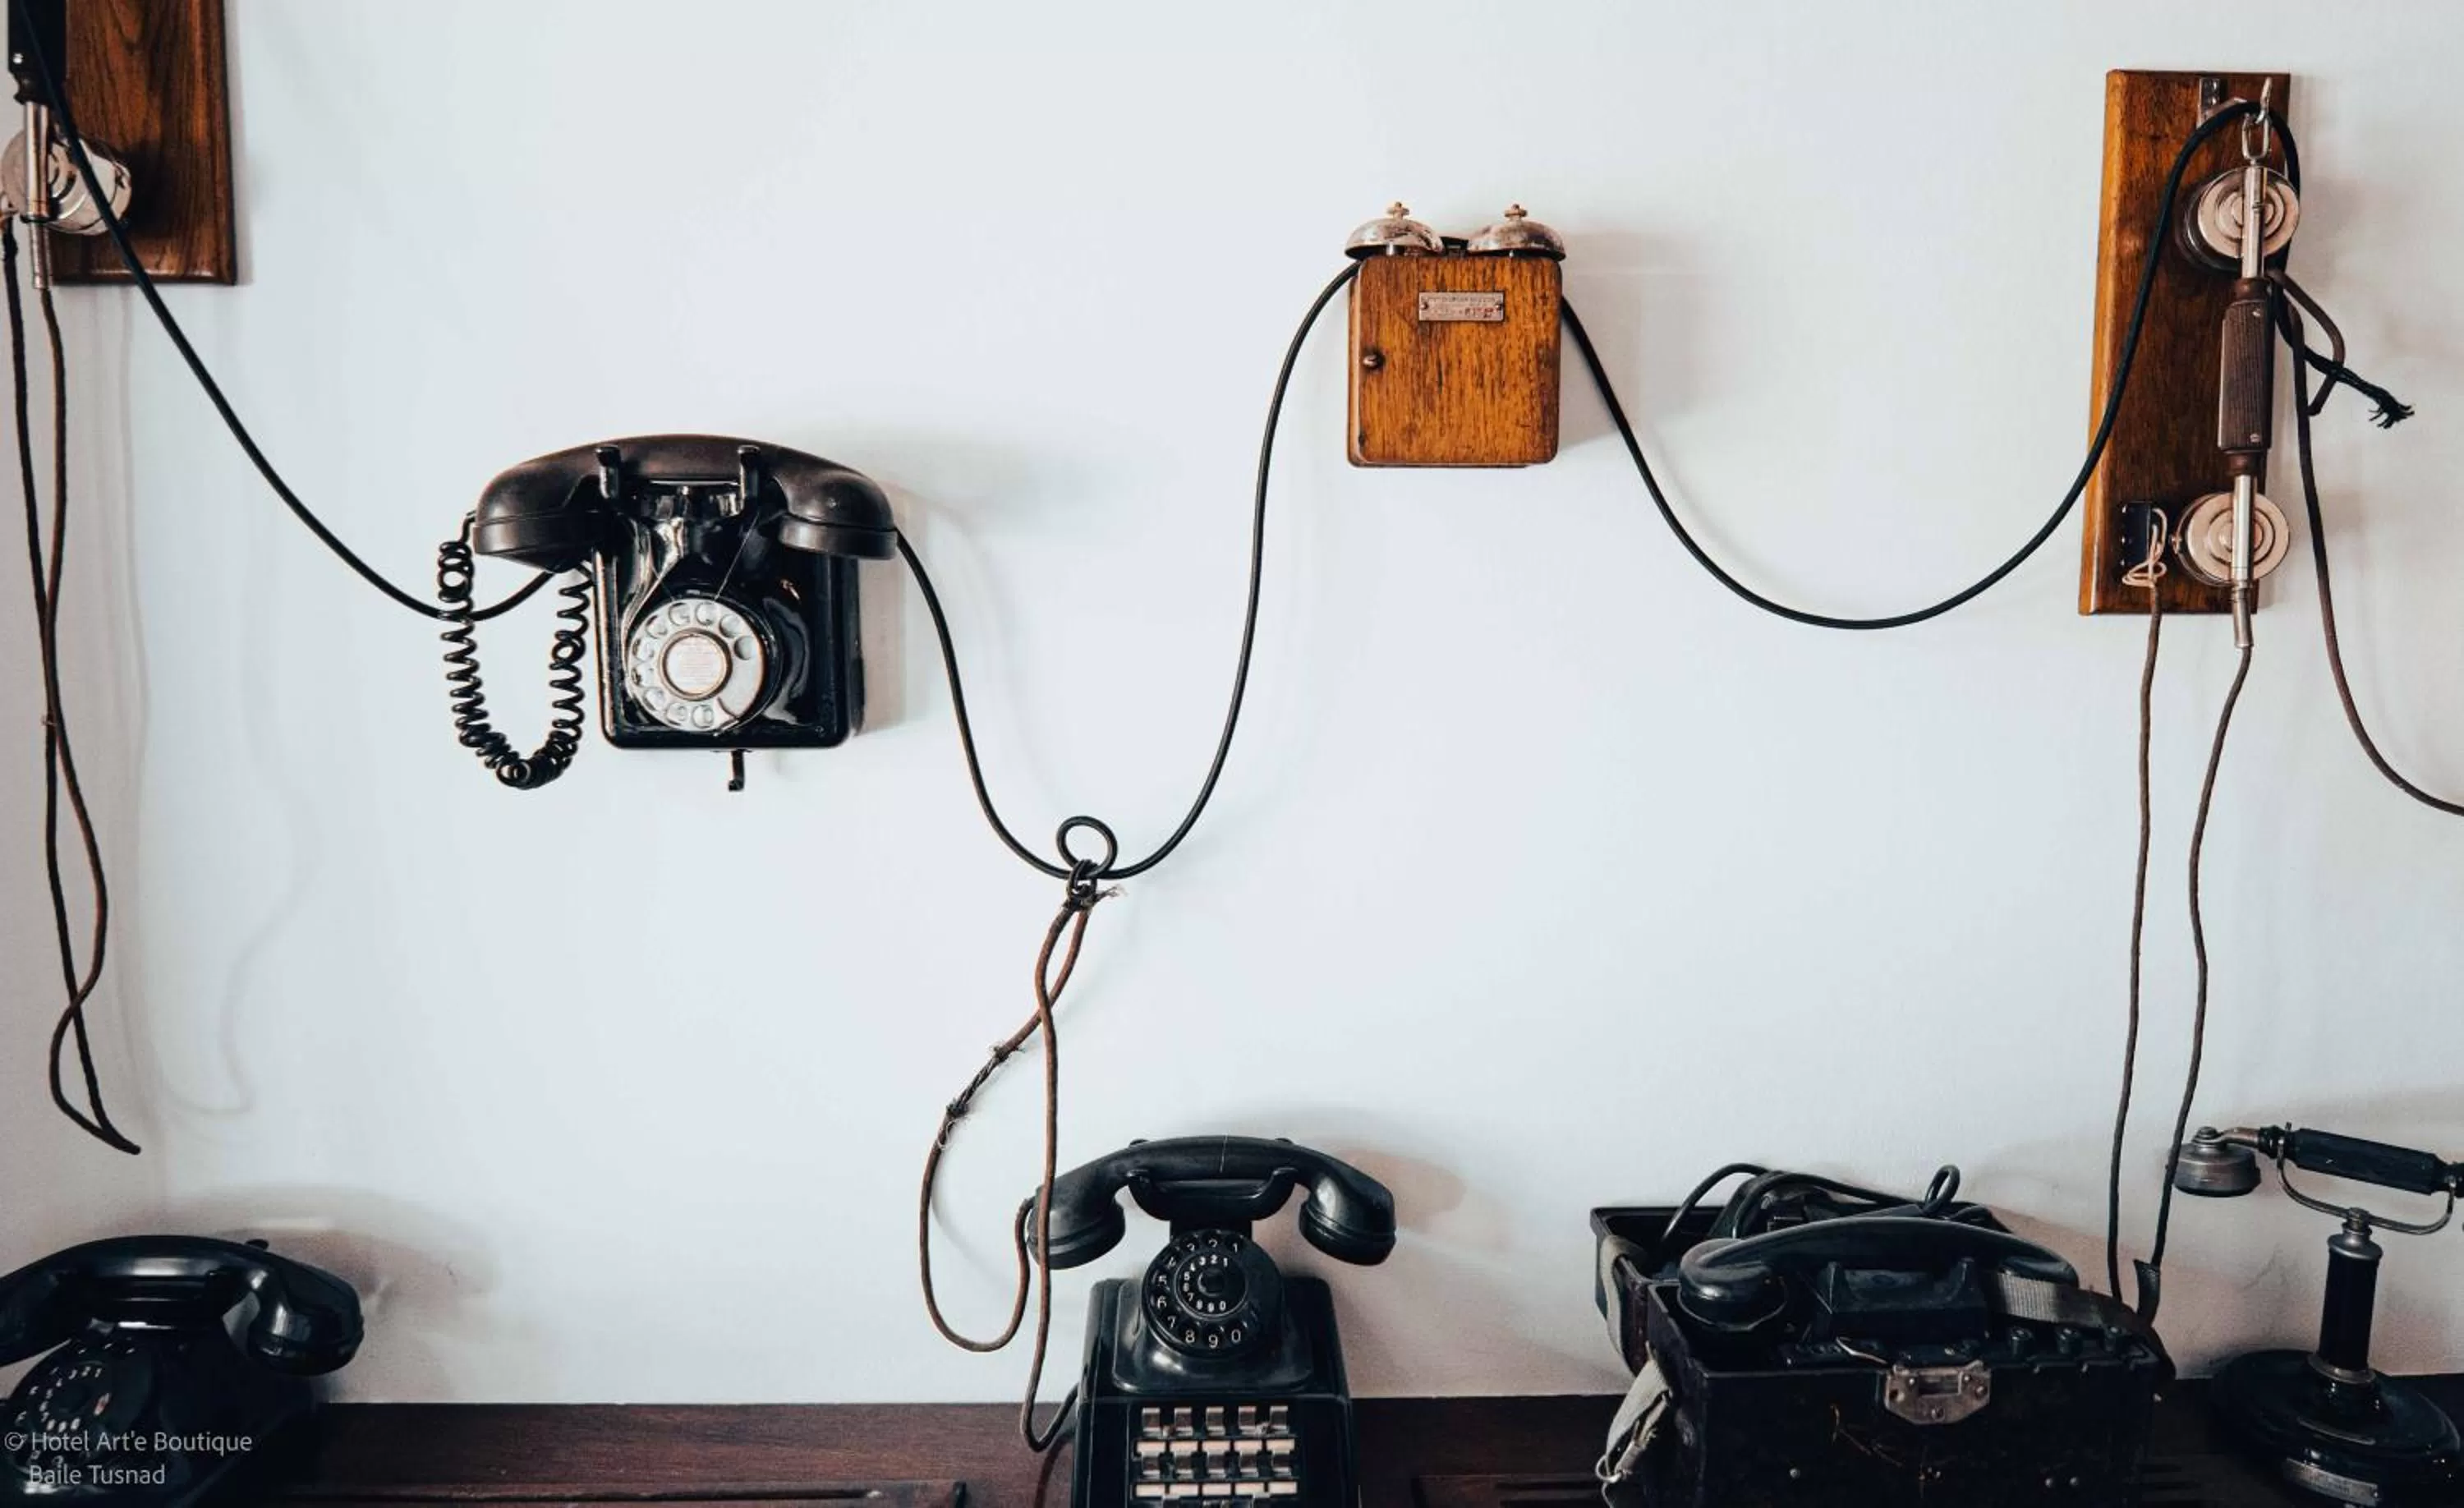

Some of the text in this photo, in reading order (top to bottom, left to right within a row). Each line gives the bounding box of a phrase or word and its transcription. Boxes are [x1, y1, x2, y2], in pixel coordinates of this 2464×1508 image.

[1232, 1242, 1238, 1253] 1
[1199, 1256, 1207, 1266] 3
[1211, 1254, 1219, 1264] 2
[1184, 1271, 1191, 1281] 5
[1156, 1295, 1167, 1308] 6
[1188, 1293, 1195, 1301] 7
[1219, 1301, 1226, 1312] 0
[1167, 1315, 1177, 1328] 7
[1185, 1329, 1196, 1343] 8
[1208, 1334, 1219, 1349] 9
[1231, 1329, 1241, 1344] 0
